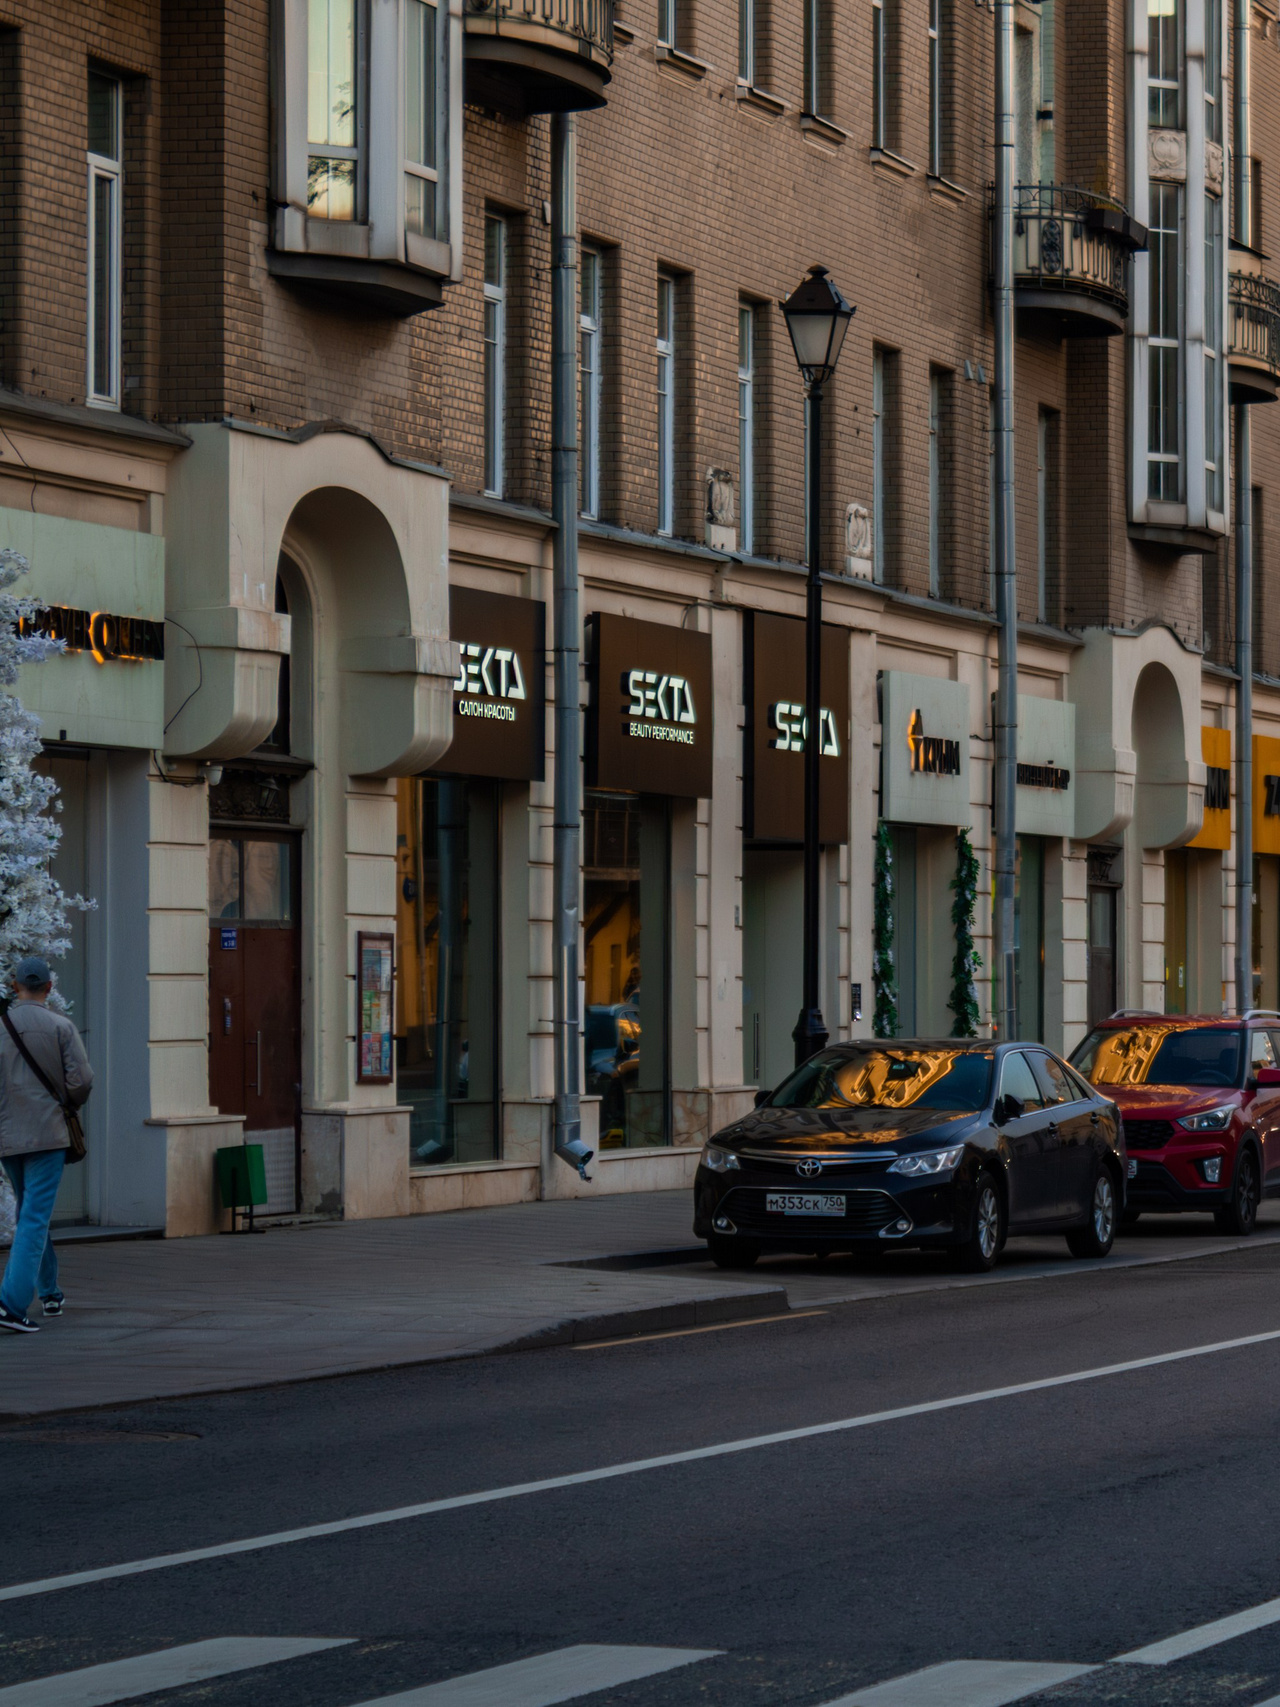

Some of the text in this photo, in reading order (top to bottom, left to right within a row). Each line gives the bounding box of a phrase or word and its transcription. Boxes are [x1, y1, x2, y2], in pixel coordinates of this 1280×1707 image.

[94, 613, 164, 662] QUEEN
[628, 670, 695, 724] SEKTA
[459, 700, 516, 721] САЛОН КРАСОТЫ
[629, 722, 694, 745] BEAUTY PERFORMANCE
[823, 1196, 842, 1207] 750
